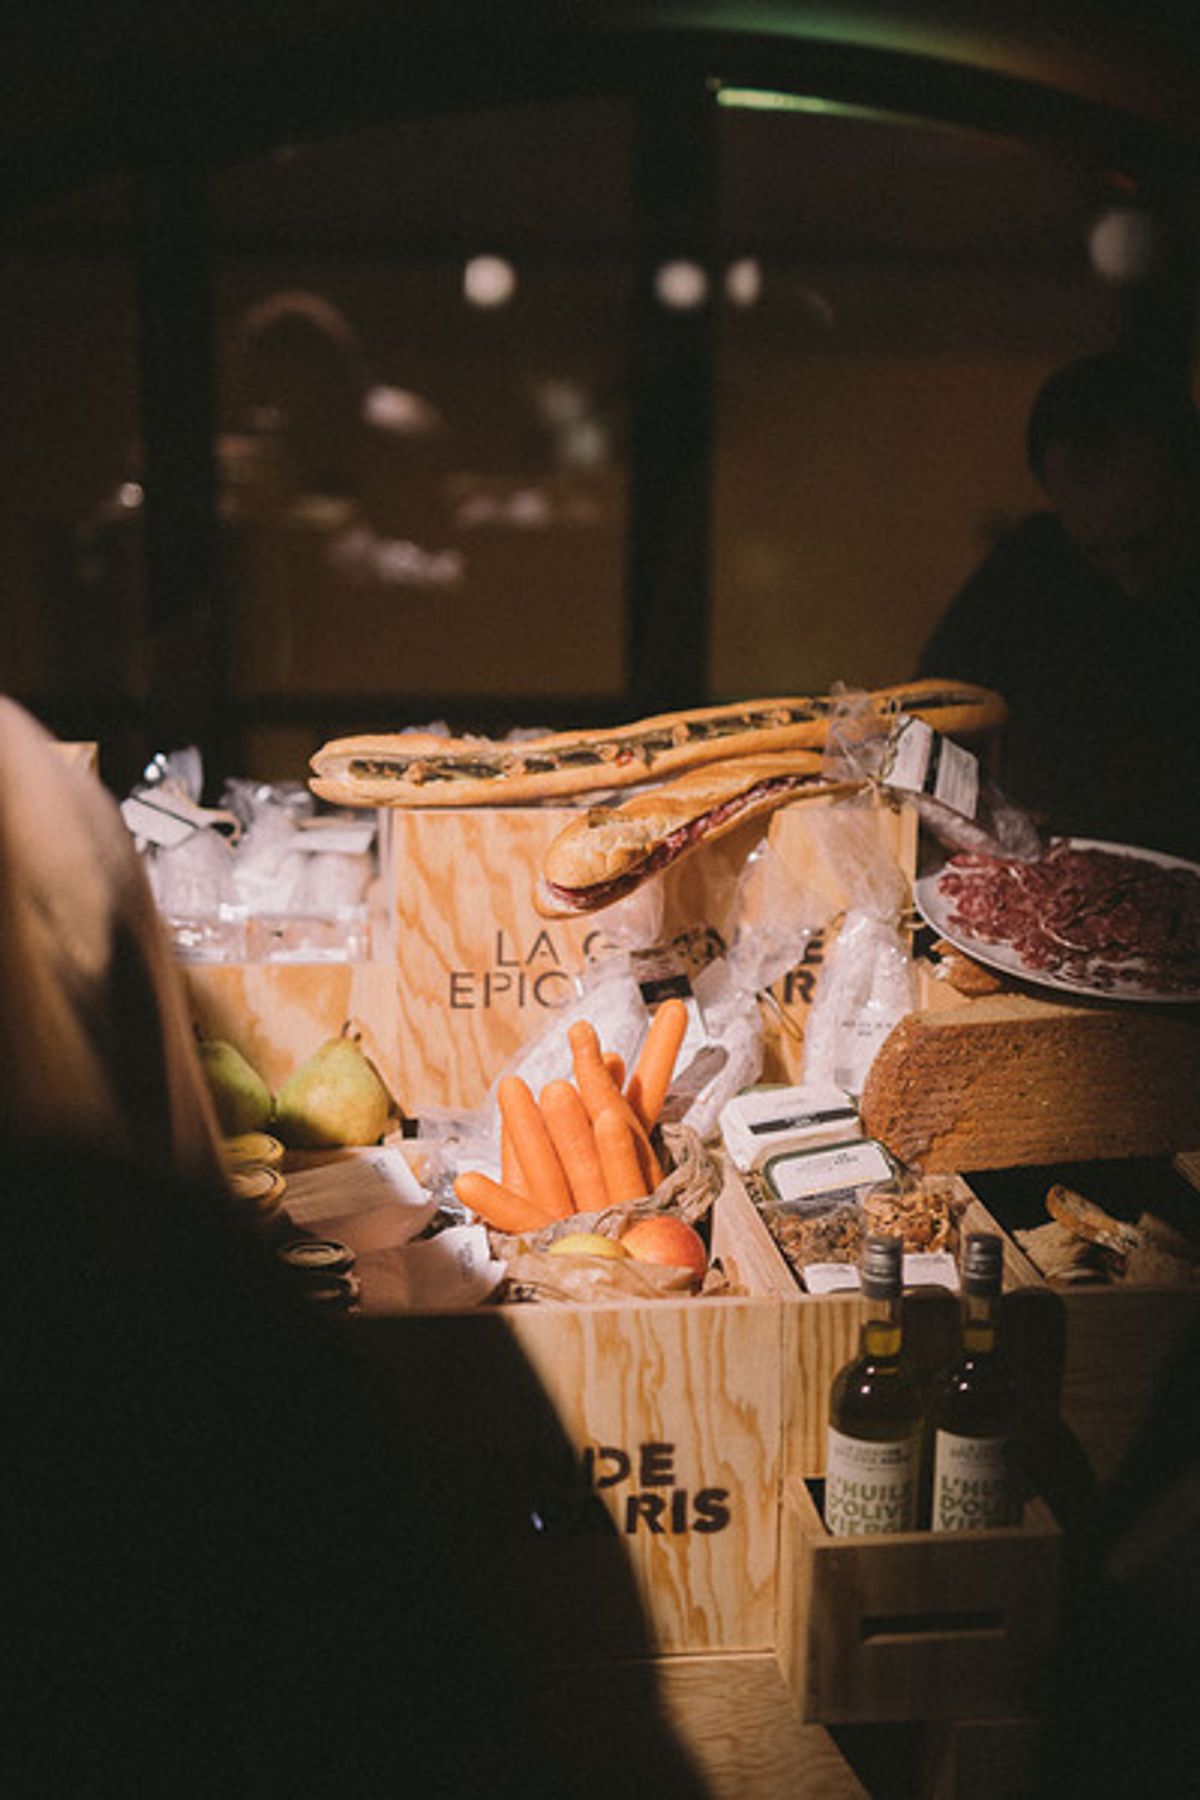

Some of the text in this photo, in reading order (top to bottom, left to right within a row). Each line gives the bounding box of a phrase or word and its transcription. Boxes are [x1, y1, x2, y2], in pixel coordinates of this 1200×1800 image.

[496, 929, 560, 967] LA
[449, 971, 571, 1010] EPIC
[584, 1443, 676, 1489] DE
[625, 1488, 732, 1535] RIS
[829, 1494, 911, 1520] D'OLIV
